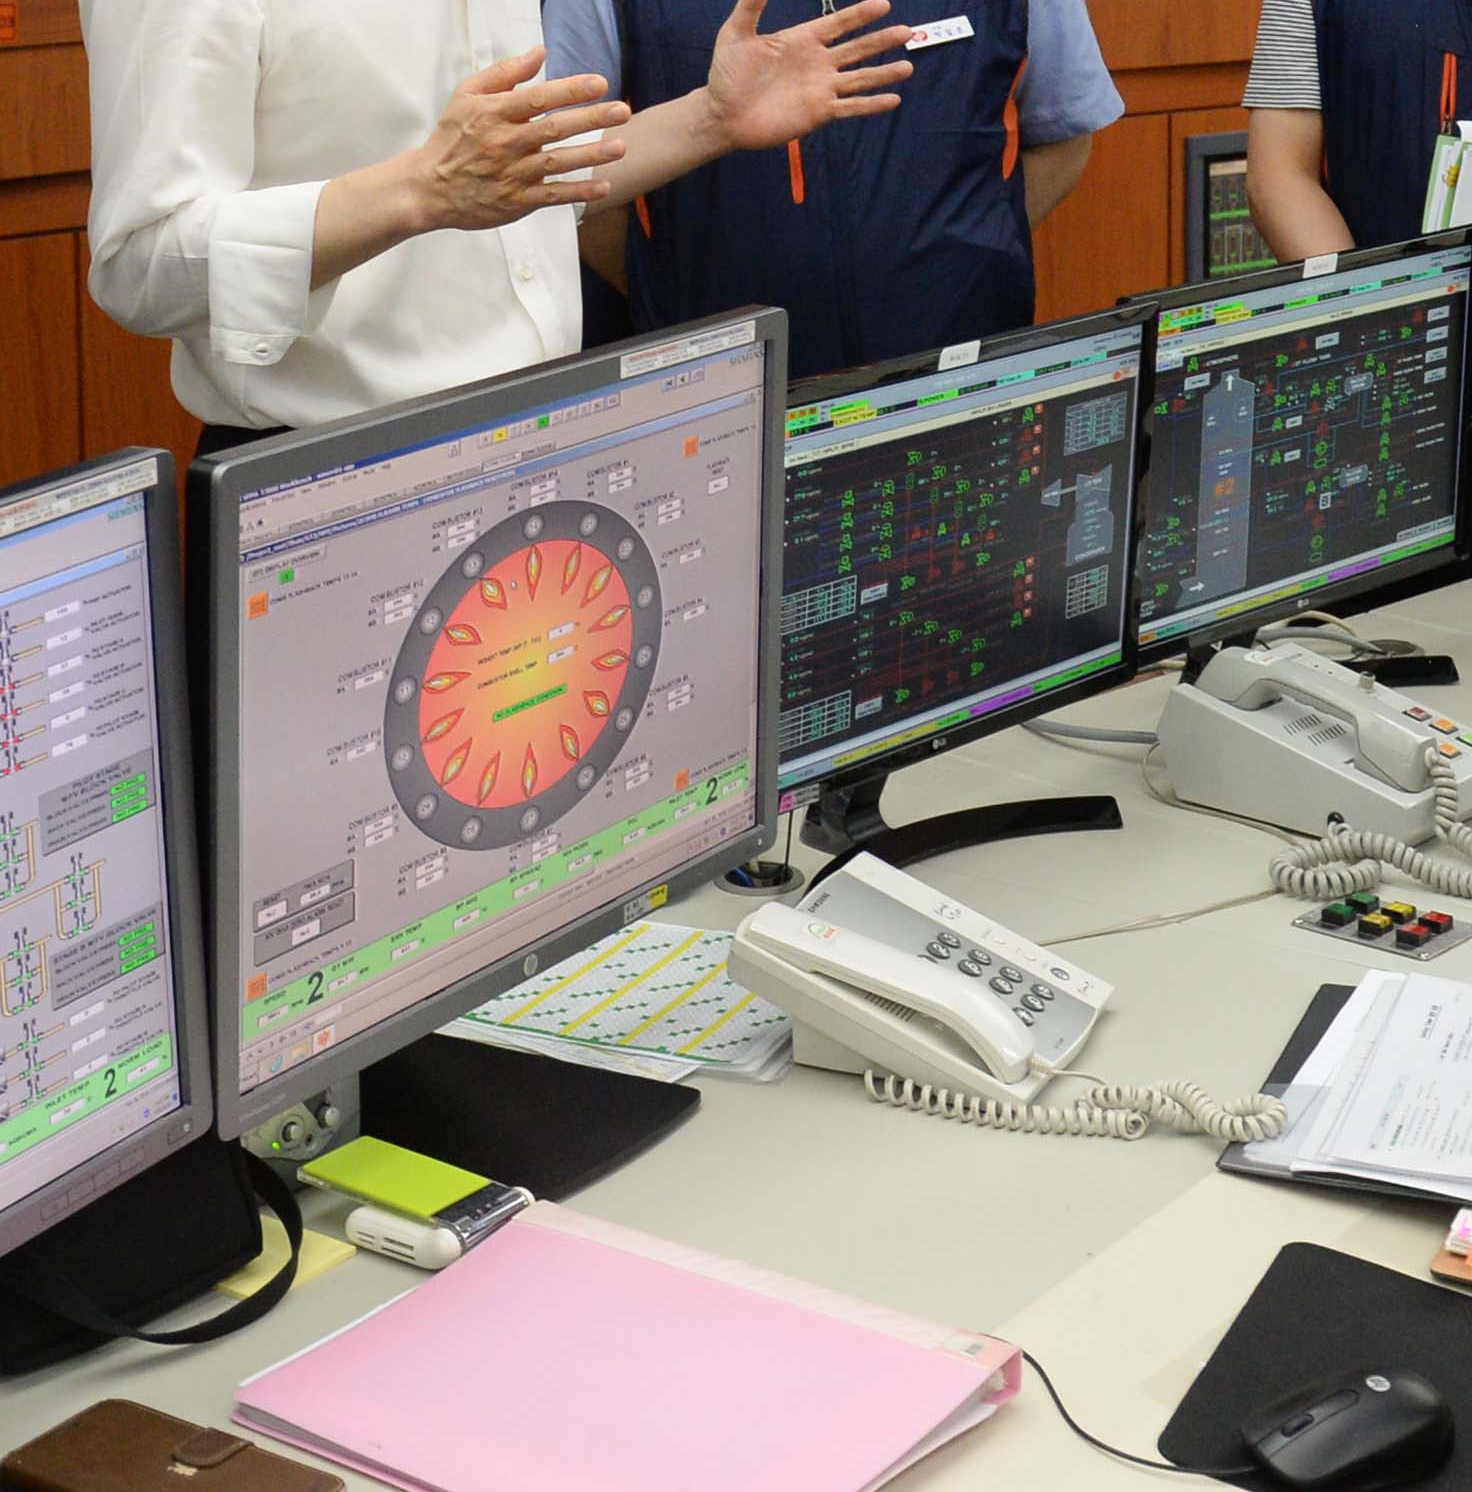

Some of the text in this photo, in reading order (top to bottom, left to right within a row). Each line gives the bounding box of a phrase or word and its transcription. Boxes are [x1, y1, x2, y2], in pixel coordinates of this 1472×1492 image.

[704, 777, 719, 806] 2
[307, 971, 325, 1006] 2
[104, 1067, 118, 1099] 2
